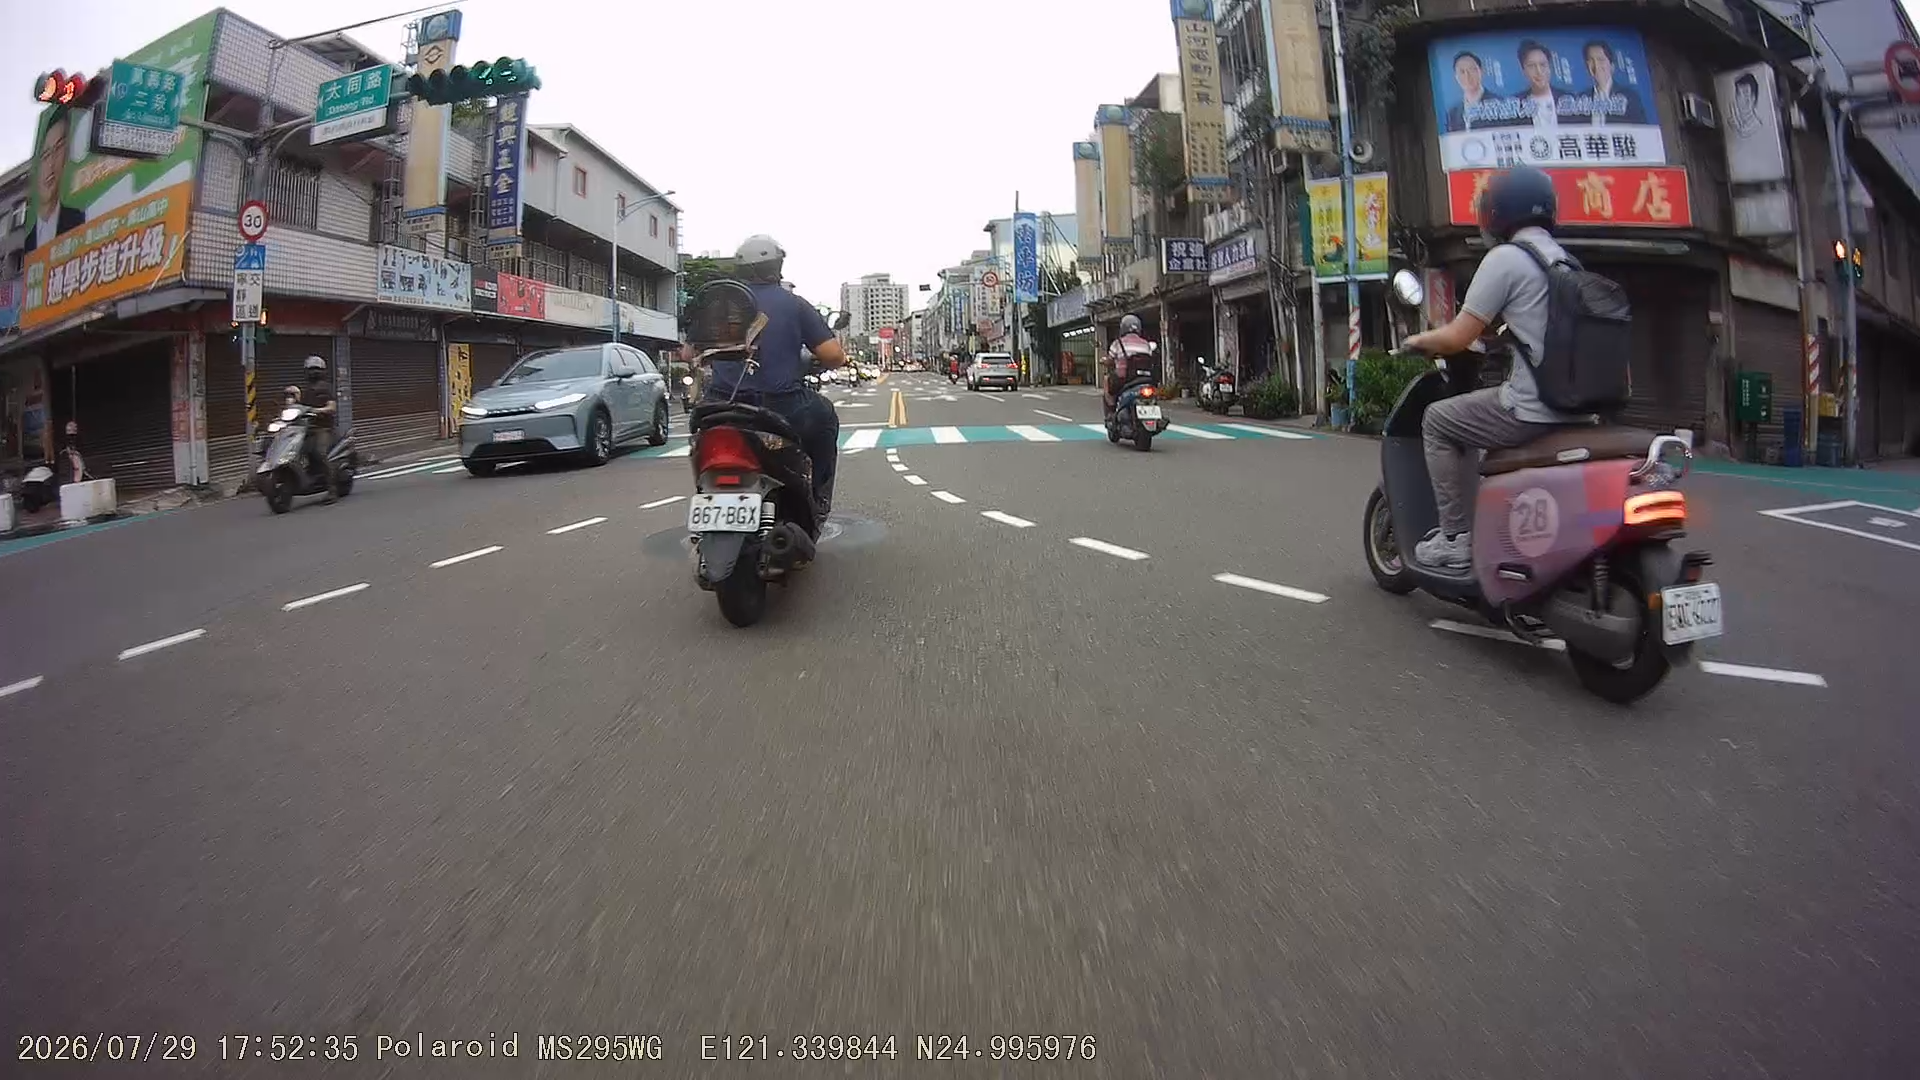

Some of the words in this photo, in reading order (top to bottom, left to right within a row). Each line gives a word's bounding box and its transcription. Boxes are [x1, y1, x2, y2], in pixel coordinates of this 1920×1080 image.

[1185, 23, 1217, 106] 山河電動工具
[325, 70, 383, 102] 大同路
[1558, 132, 1638, 160] 高華駿
[243, 214, 262, 229] 30
[691, 506, 757, 525] 867-BGX
[1513, 499, 1548, 535] 28
